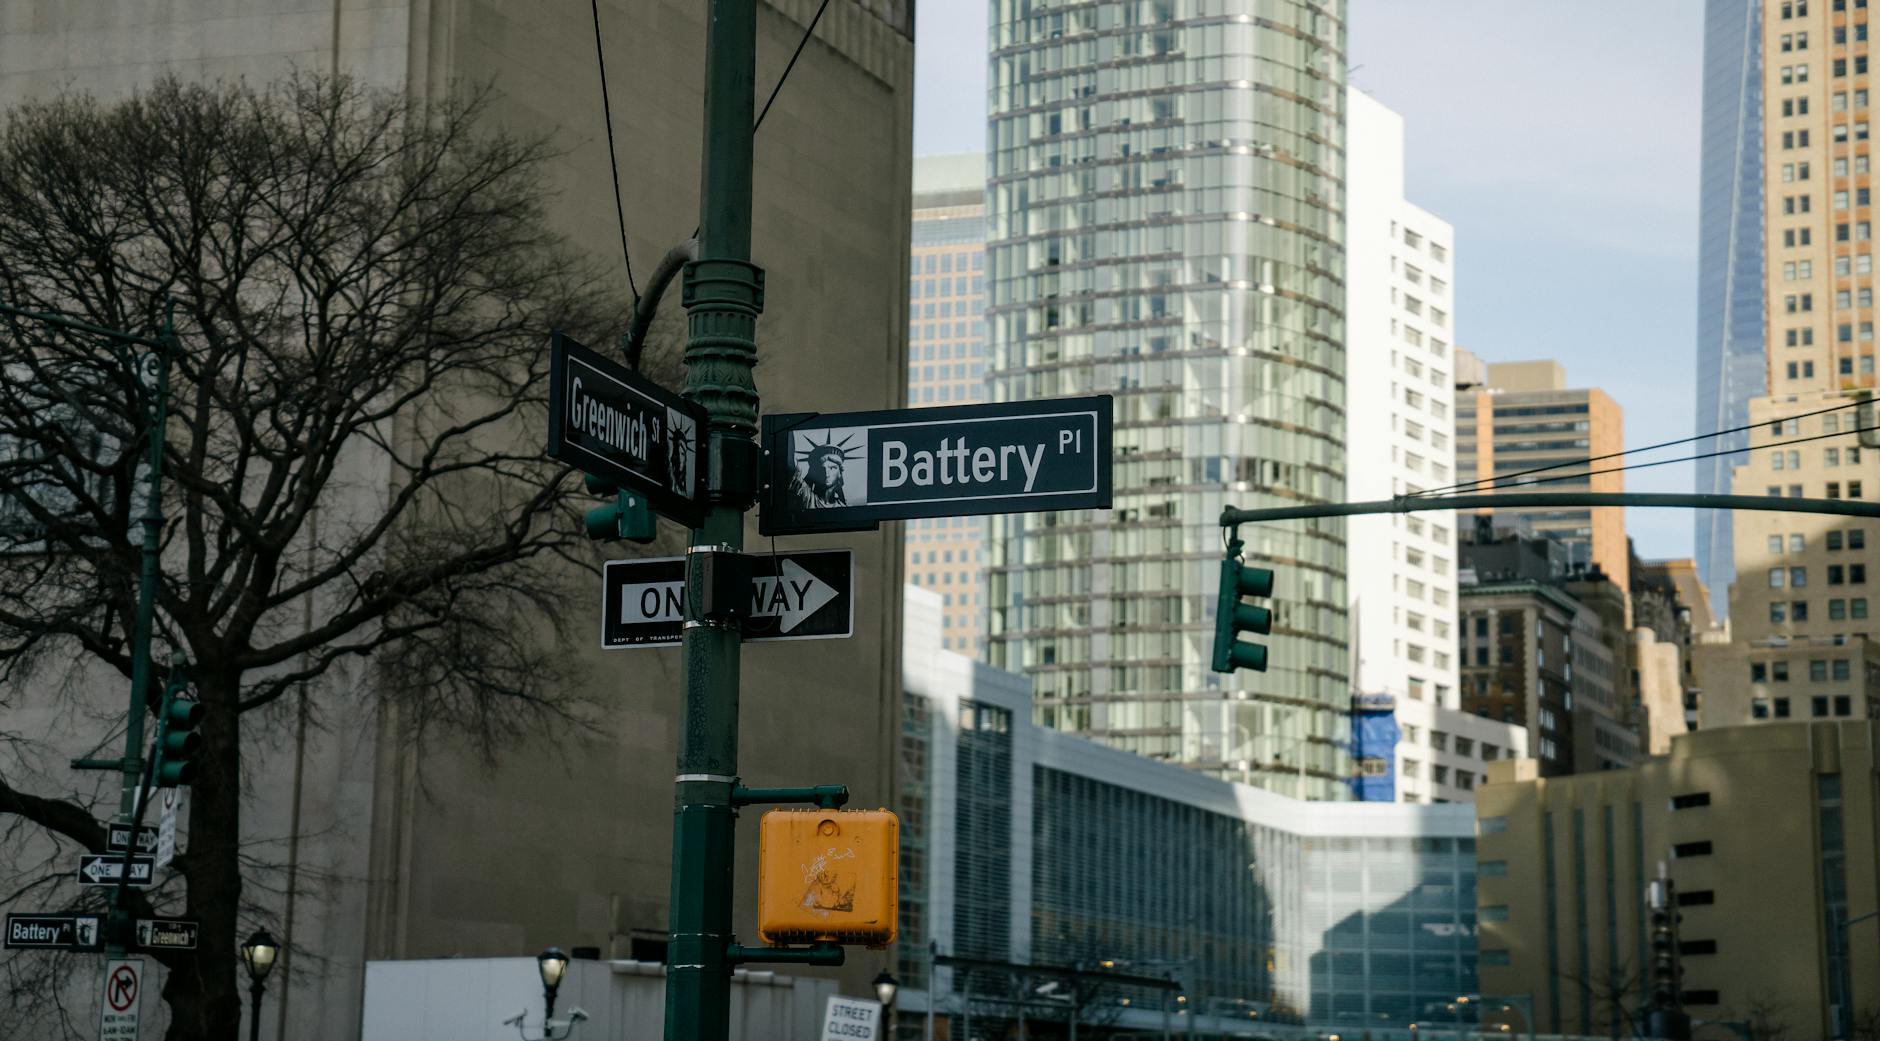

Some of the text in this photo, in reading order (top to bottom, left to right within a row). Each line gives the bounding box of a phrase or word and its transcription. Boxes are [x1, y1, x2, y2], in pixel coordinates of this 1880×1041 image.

[572, 376, 660, 461] Greenwich St
[881, 429, 1081, 493] Battery Pl
[640, 586, 684, 618] ON
[116, 831, 127, 843] ON
[90, 864, 144, 876] ONE AY
[13, 922, 60, 944] Battery
[832, 1004, 873, 1021] STREET
[828, 1021, 870, 1038] CLOSED
